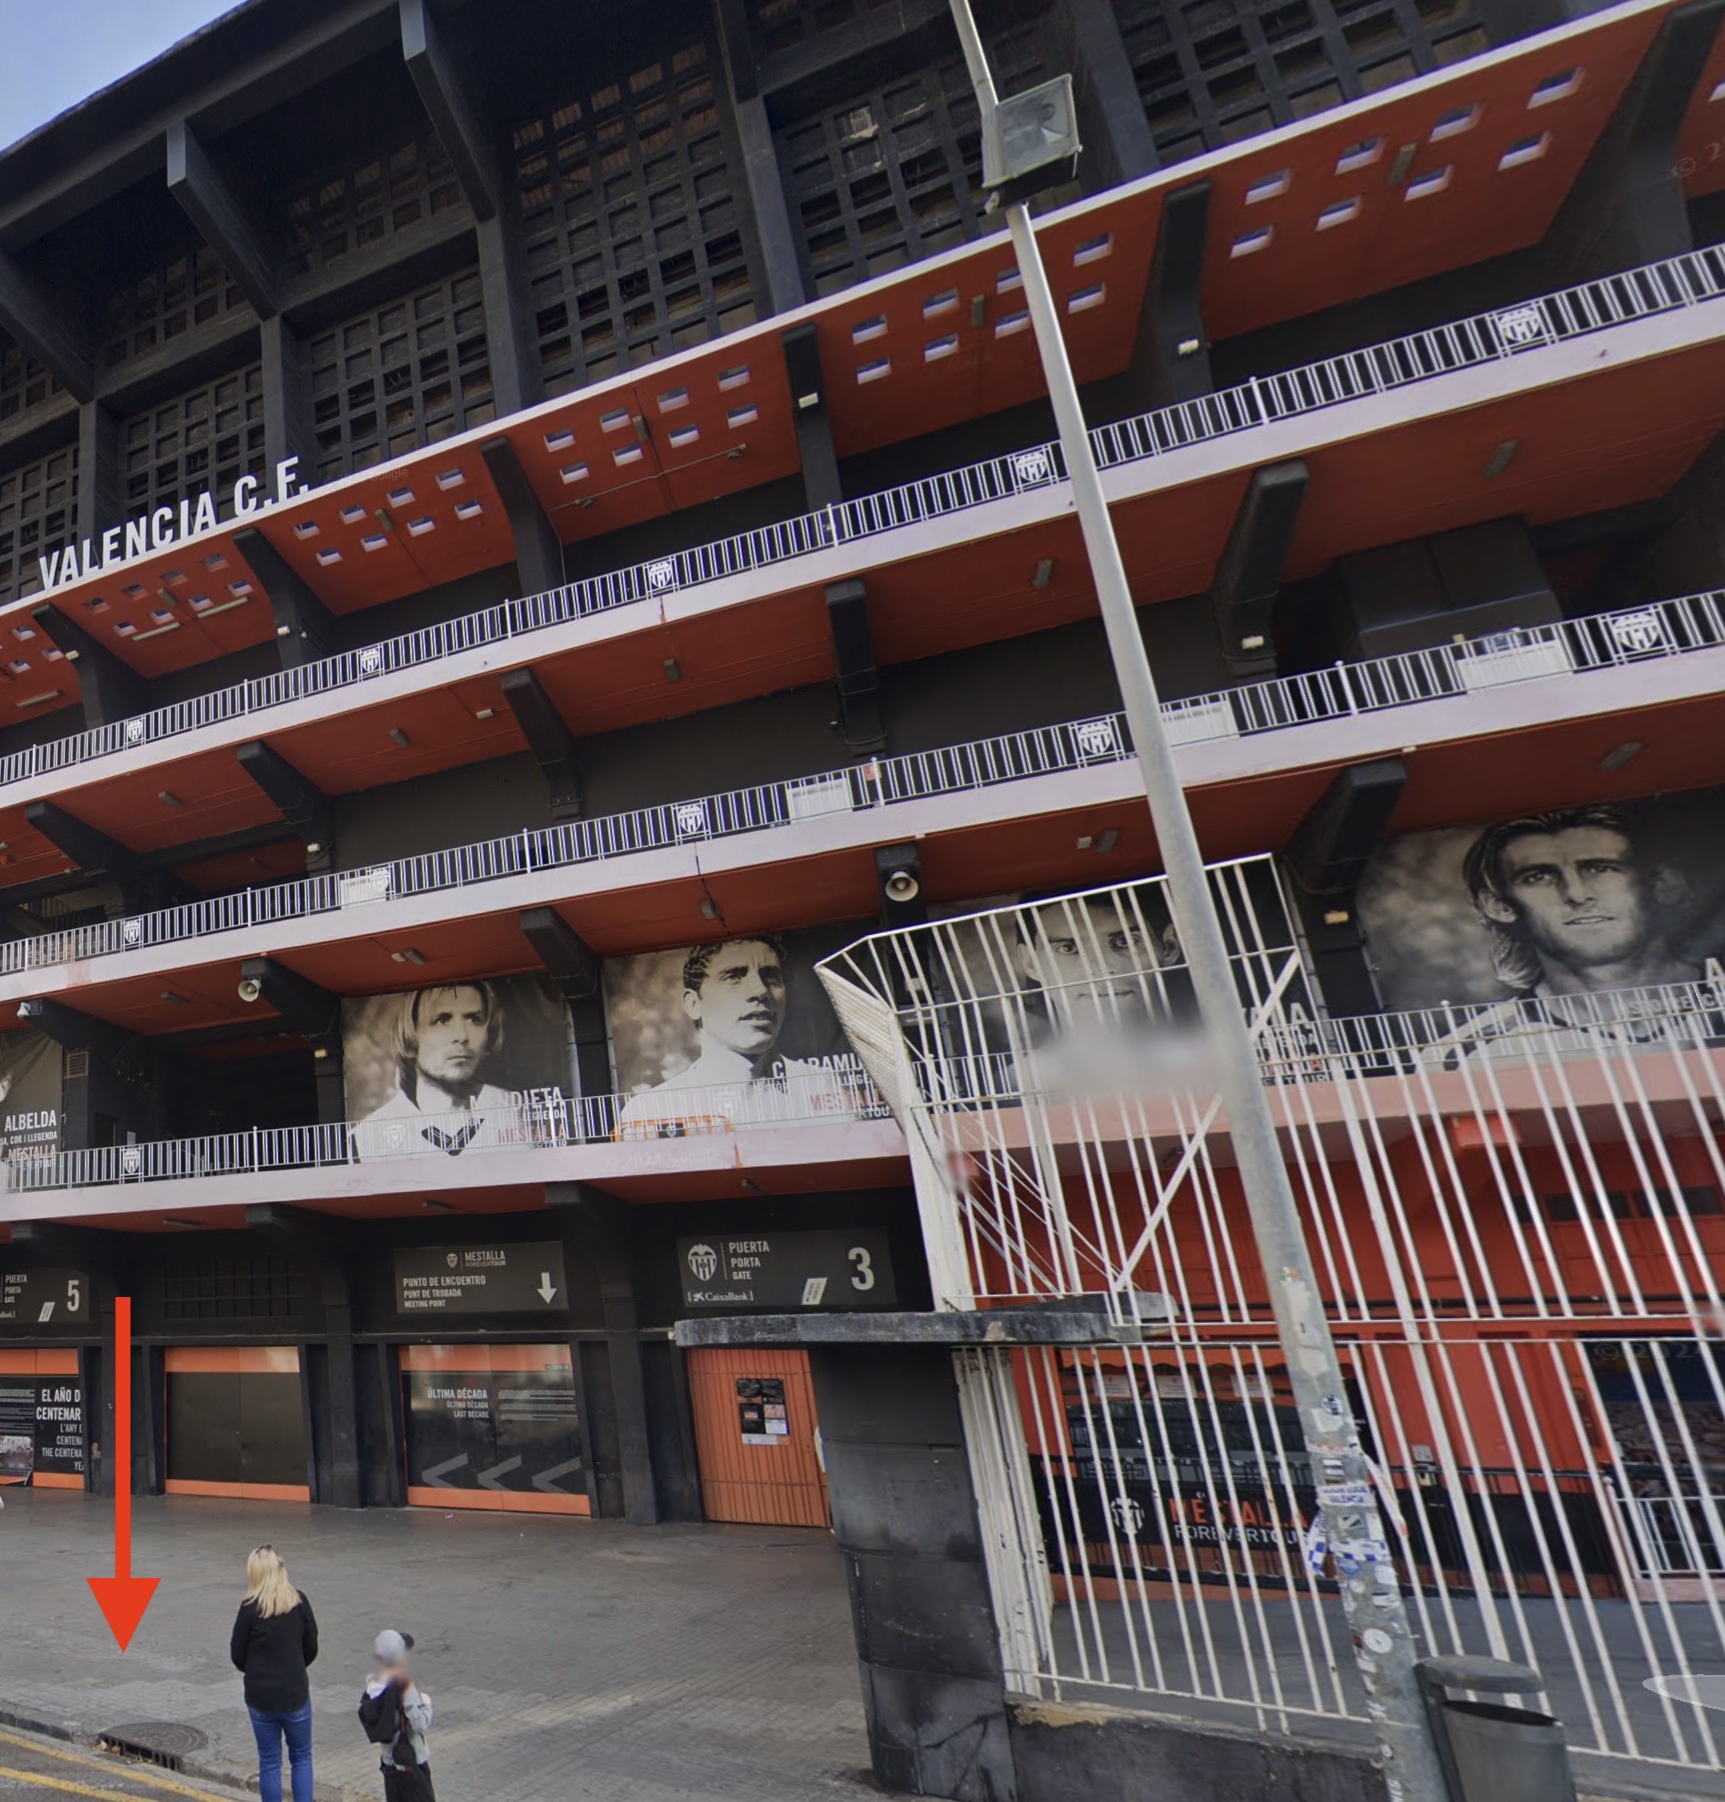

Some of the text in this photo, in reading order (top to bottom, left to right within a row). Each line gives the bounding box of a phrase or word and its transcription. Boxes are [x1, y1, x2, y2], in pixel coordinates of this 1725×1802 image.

[39, 456, 309, 592] VALENCIA C.F.
[4, 1109, 57, 1132] ALBELDA
[9, 1135, 22, 1145] COR
[27, 1130, 58, 1143] LLEGENDA
[729, 1240, 770, 1254] PUERTA
[464, 1250, 506, 1262] MESTALLA
[731, 1257, 761, 1268] PORTA
[847, 1246, 875, 1291] 3
[5, 1274, 28, 1284] PUERTA
[403, 1275, 486, 1288] PUNTO DE ENCUENTRO
[732, 1271, 752, 1280] GATE
[5, 1286, 22, 1295] PORTA
[67, 1279, 80, 1312] 5
[403, 1288, 462, 1299] PUNT DE TROBADA
[404, 1299, 446, 1309] MEETING POINT
[41, 1389, 52, 1403] EL
[53, 1386, 73, 1403] AÑO
[427, 1387, 456, 1400] ÚLTIMA
[457, 1387, 488, 1400] DÉCADA
[36, 1406, 82, 1421] CENTENAR
[454, 1411, 466, 1419] LAST
[42, 1447, 53, 1458] THE
